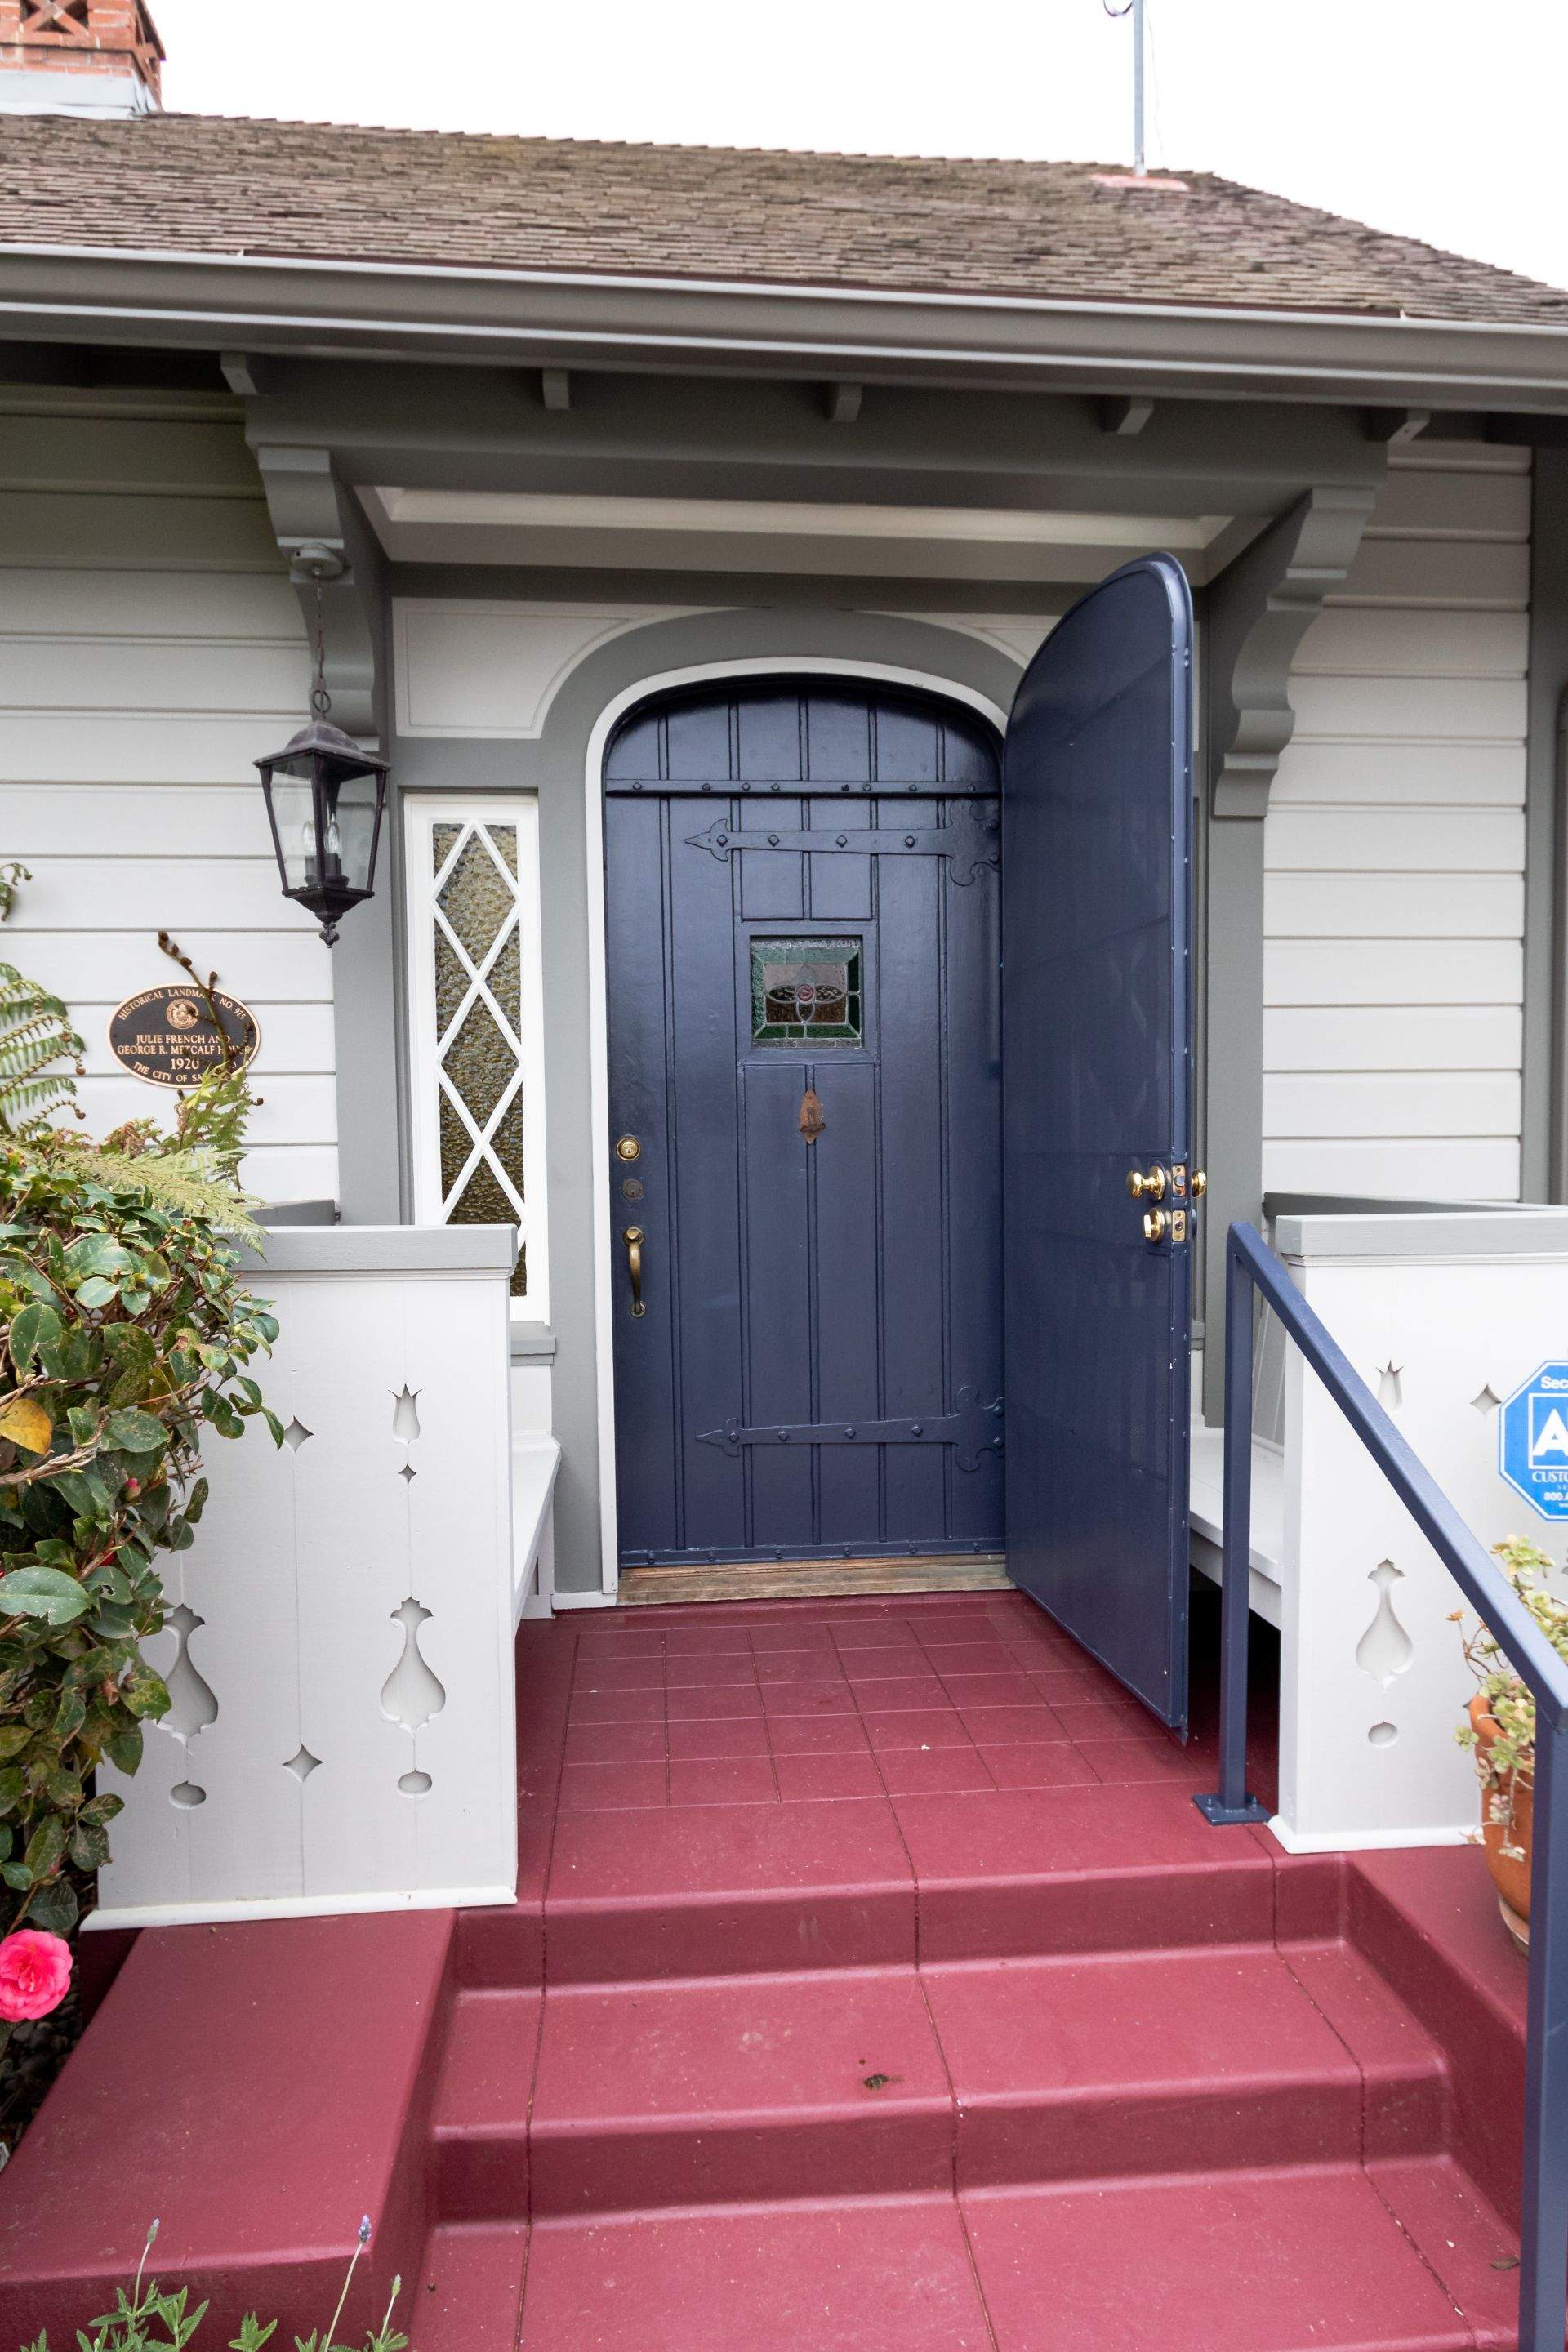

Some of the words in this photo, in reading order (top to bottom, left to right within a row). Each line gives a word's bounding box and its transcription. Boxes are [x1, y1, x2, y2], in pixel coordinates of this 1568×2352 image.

[118, 991, 164, 1021] HISTORICAL
[167, 988, 216, 1002] LANDMA
[219, 997, 233, 1010] NO.
[234, 1007, 247, 1019] 975
[136, 1034, 163, 1045] JULIE
[165, 1034, 205, 1044] FRENCH
[117, 1045, 156, 1054] GEORGE
[158, 1045, 168, 1054] R.
[132, 1061, 149, 1075] THE
[152, 1070, 172, 1081] CITY
[176, 1074, 188, 1082] OF
[170, 1058, 199, 1070] 1920
[1541, 1375, 1568, 1390] Sec
[1532, 1407, 1568, 1456] A
